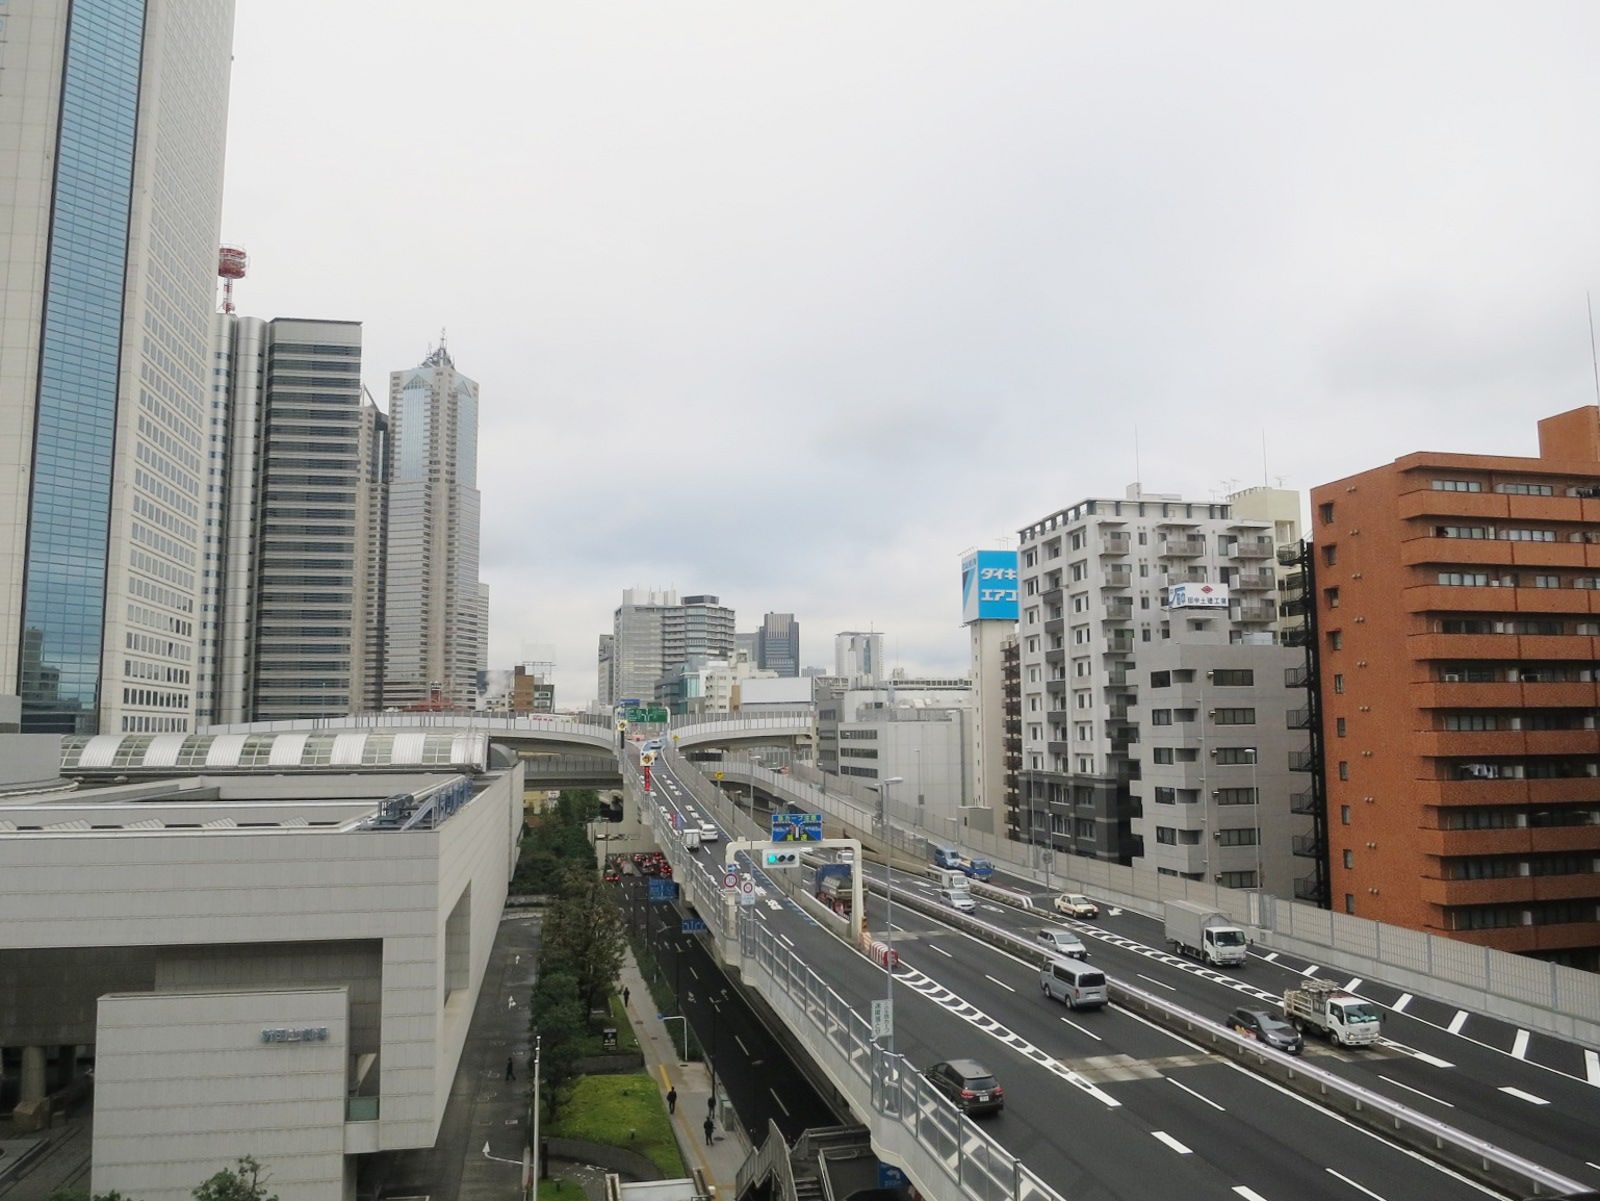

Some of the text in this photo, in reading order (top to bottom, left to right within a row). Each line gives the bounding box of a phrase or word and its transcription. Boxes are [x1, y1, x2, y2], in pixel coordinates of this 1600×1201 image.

[981, 568, 1016, 579] ダイキ
[981, 590, 1017, 601] エアコ
